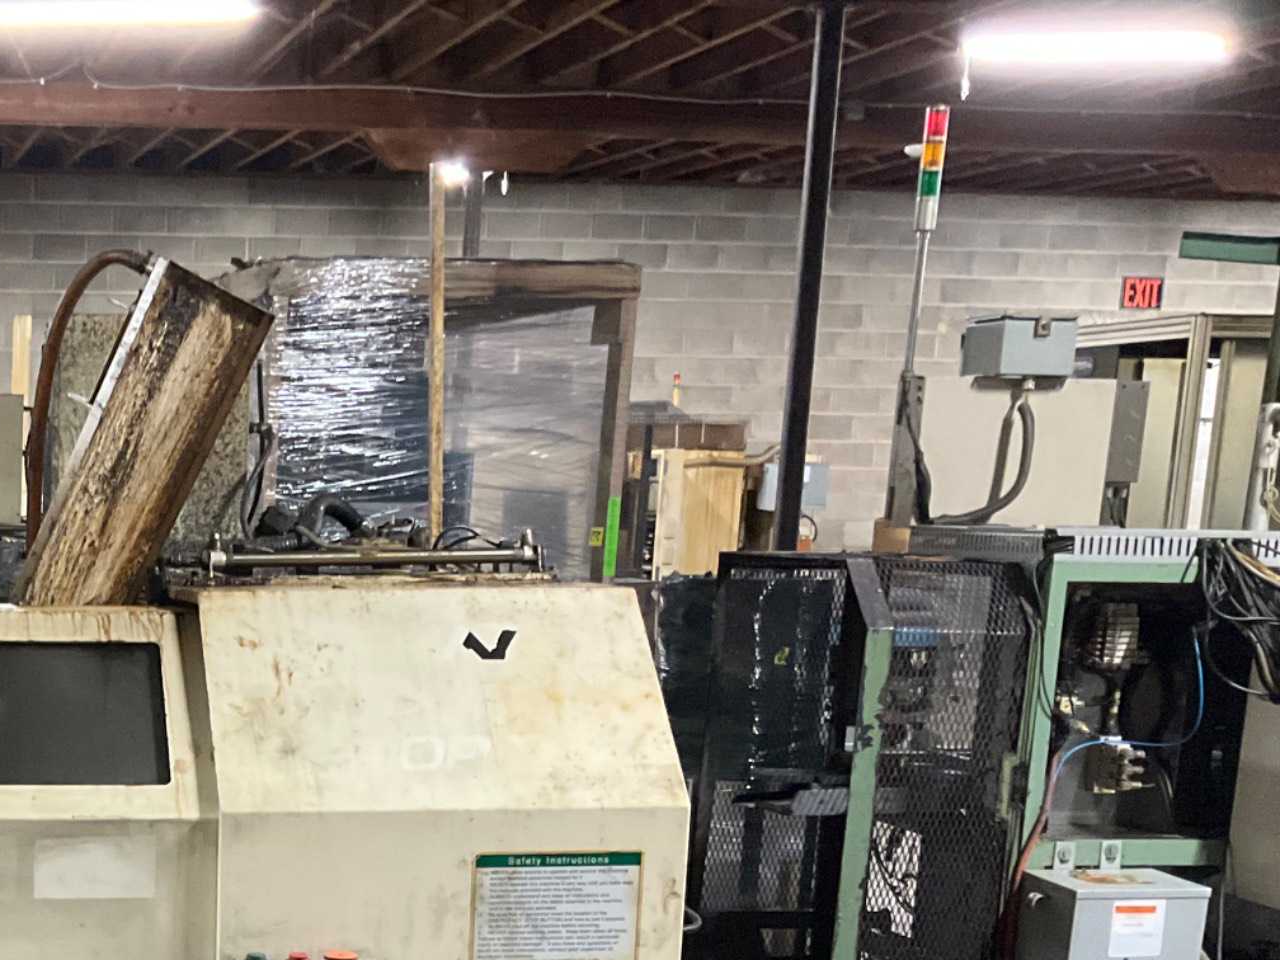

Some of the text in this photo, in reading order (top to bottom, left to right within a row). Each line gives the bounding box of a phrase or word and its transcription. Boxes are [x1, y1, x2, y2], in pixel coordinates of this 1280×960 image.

[1123, 277, 1162, 309] EXIT
[507, 855, 610, 866] Safety Instructions
